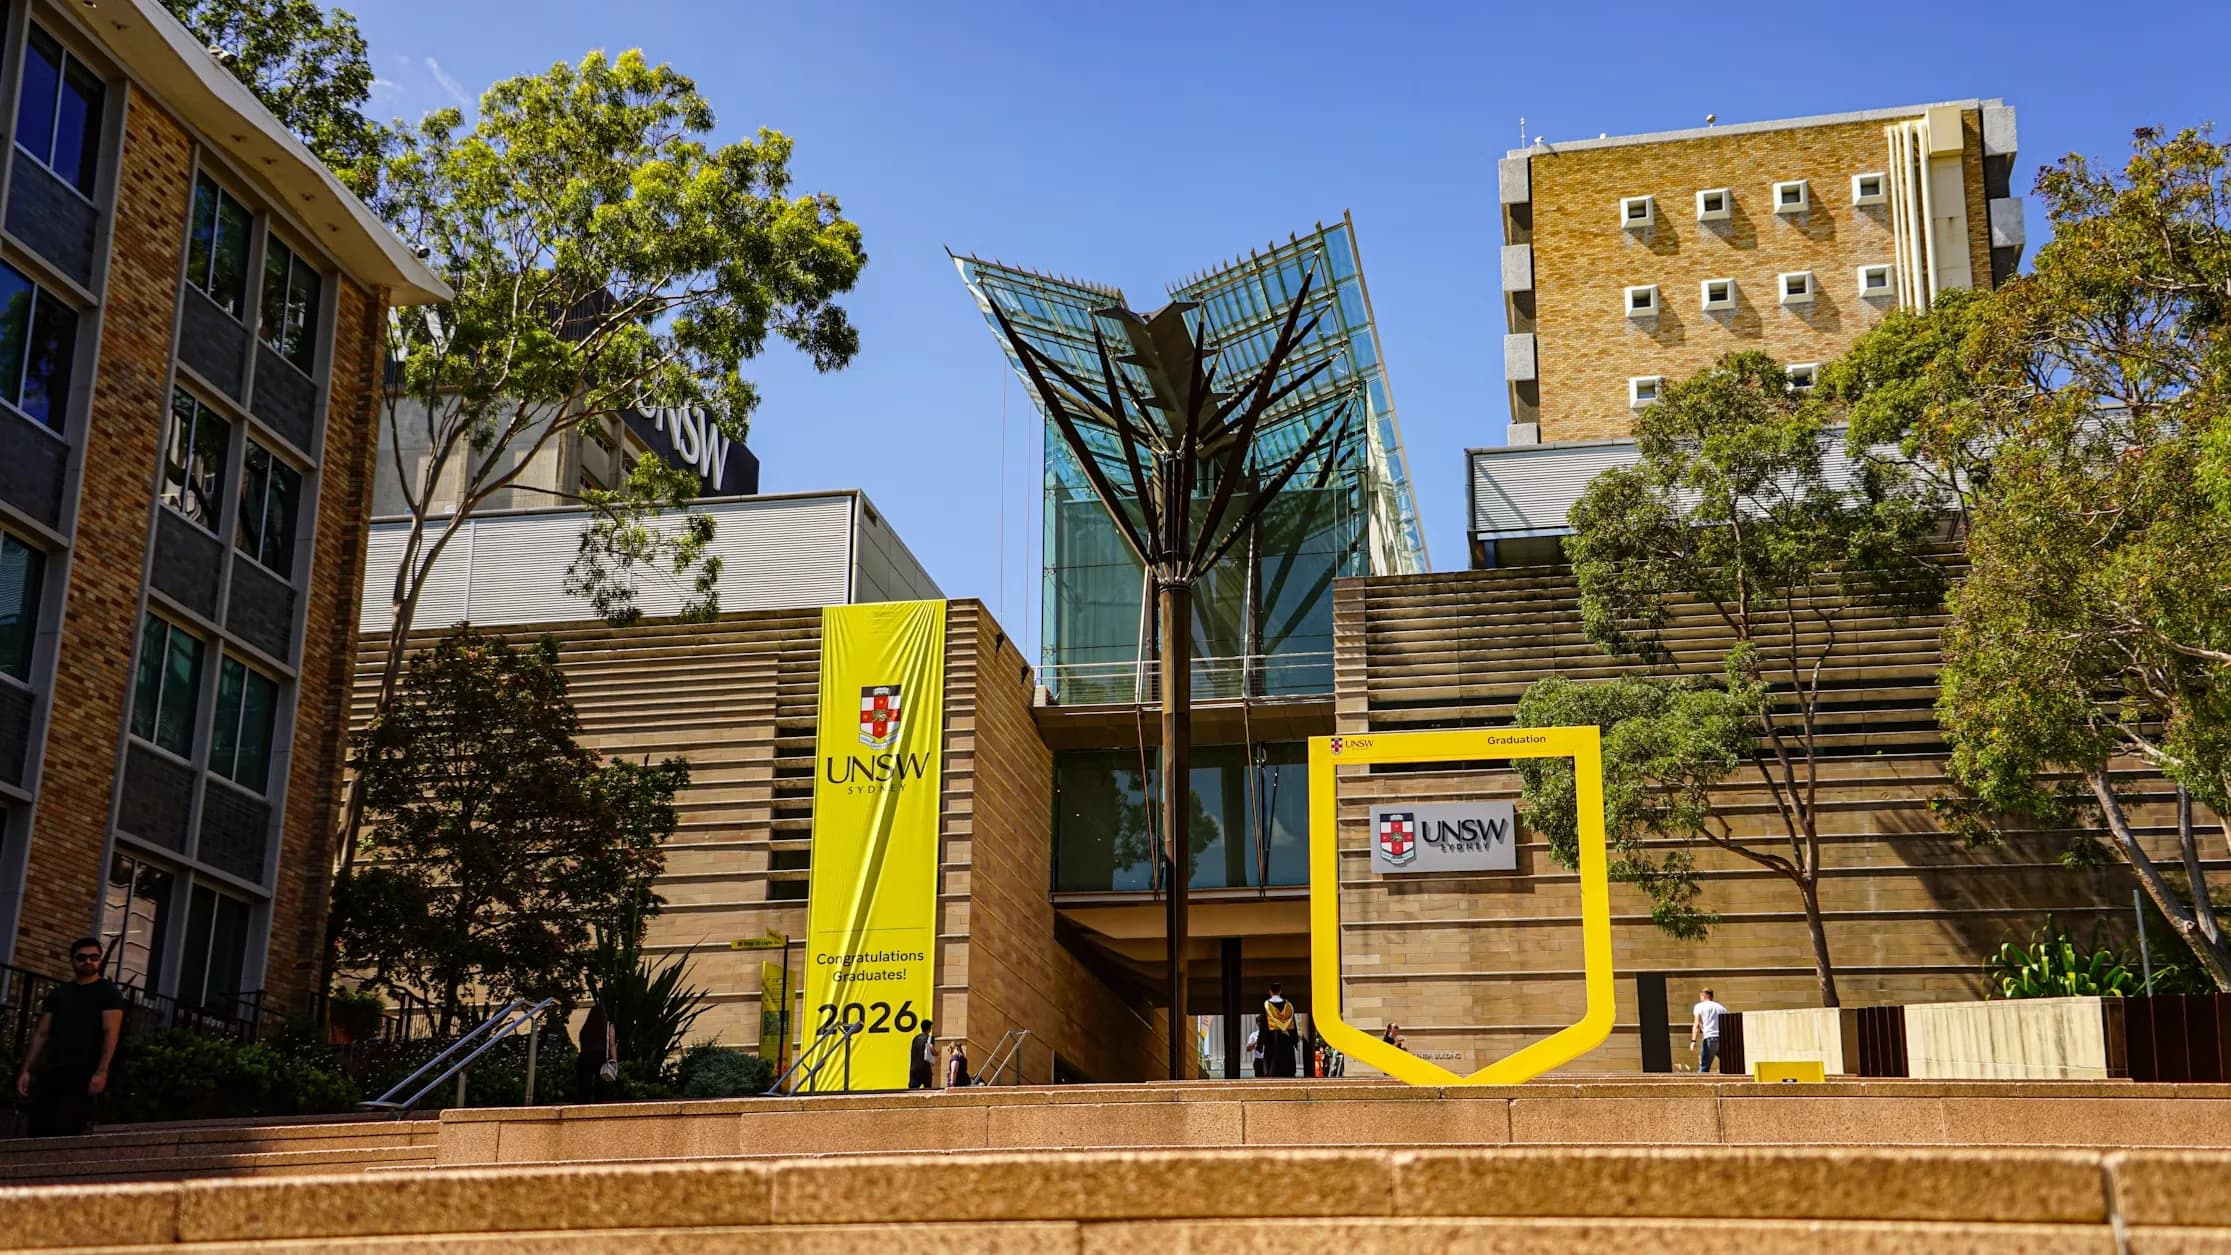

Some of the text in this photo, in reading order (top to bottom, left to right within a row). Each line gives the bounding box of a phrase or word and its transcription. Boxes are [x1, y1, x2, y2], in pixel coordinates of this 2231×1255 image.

[1345, 738, 1374, 748] UNSW
[1487, 735, 1546, 745] Graduation
[827, 752, 930, 784] UNSW
[848, 784, 906, 795] SYDNEY
[1421, 818, 1507, 843] UNSW
[1440, 842, 1490, 853] SYDNEY
[816, 950, 925, 967] Congratulations
[832, 968, 907, 982] Graduates!
[816, 1000, 918, 1036] 2026
